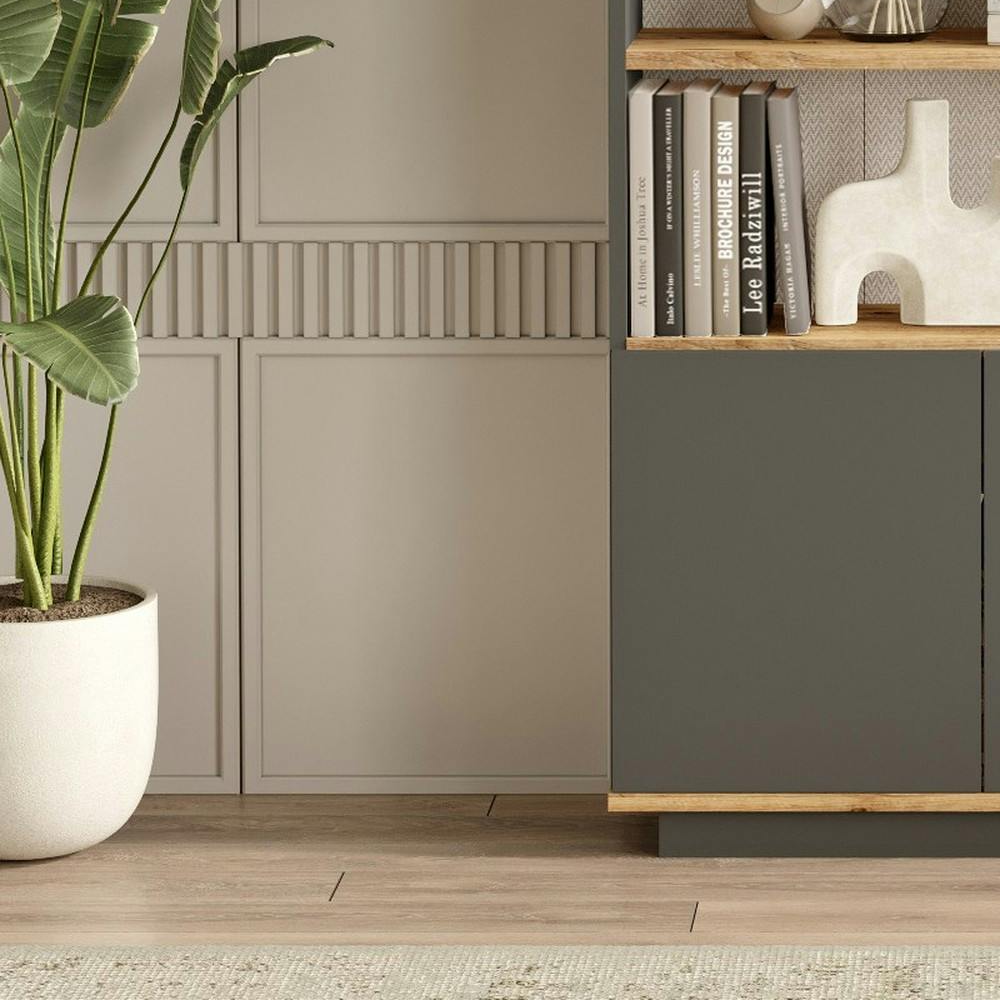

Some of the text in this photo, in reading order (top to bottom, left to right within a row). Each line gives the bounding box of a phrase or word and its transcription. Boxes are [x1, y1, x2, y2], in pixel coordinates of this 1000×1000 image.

[717, 121, 733, 174] DESIGN
[637, 176, 648, 309] At Home in Joshua Tree
[717, 179, 733, 259] BROCHURE
[741, 173, 763, 314] Lee Radziwill
[775, 144, 797, 319] VICTORIA HAGAN INTERIOR PORTRAITS
[666, 273, 675, 325] Italo Calvino
[692, 252, 702, 287] LESLIE
